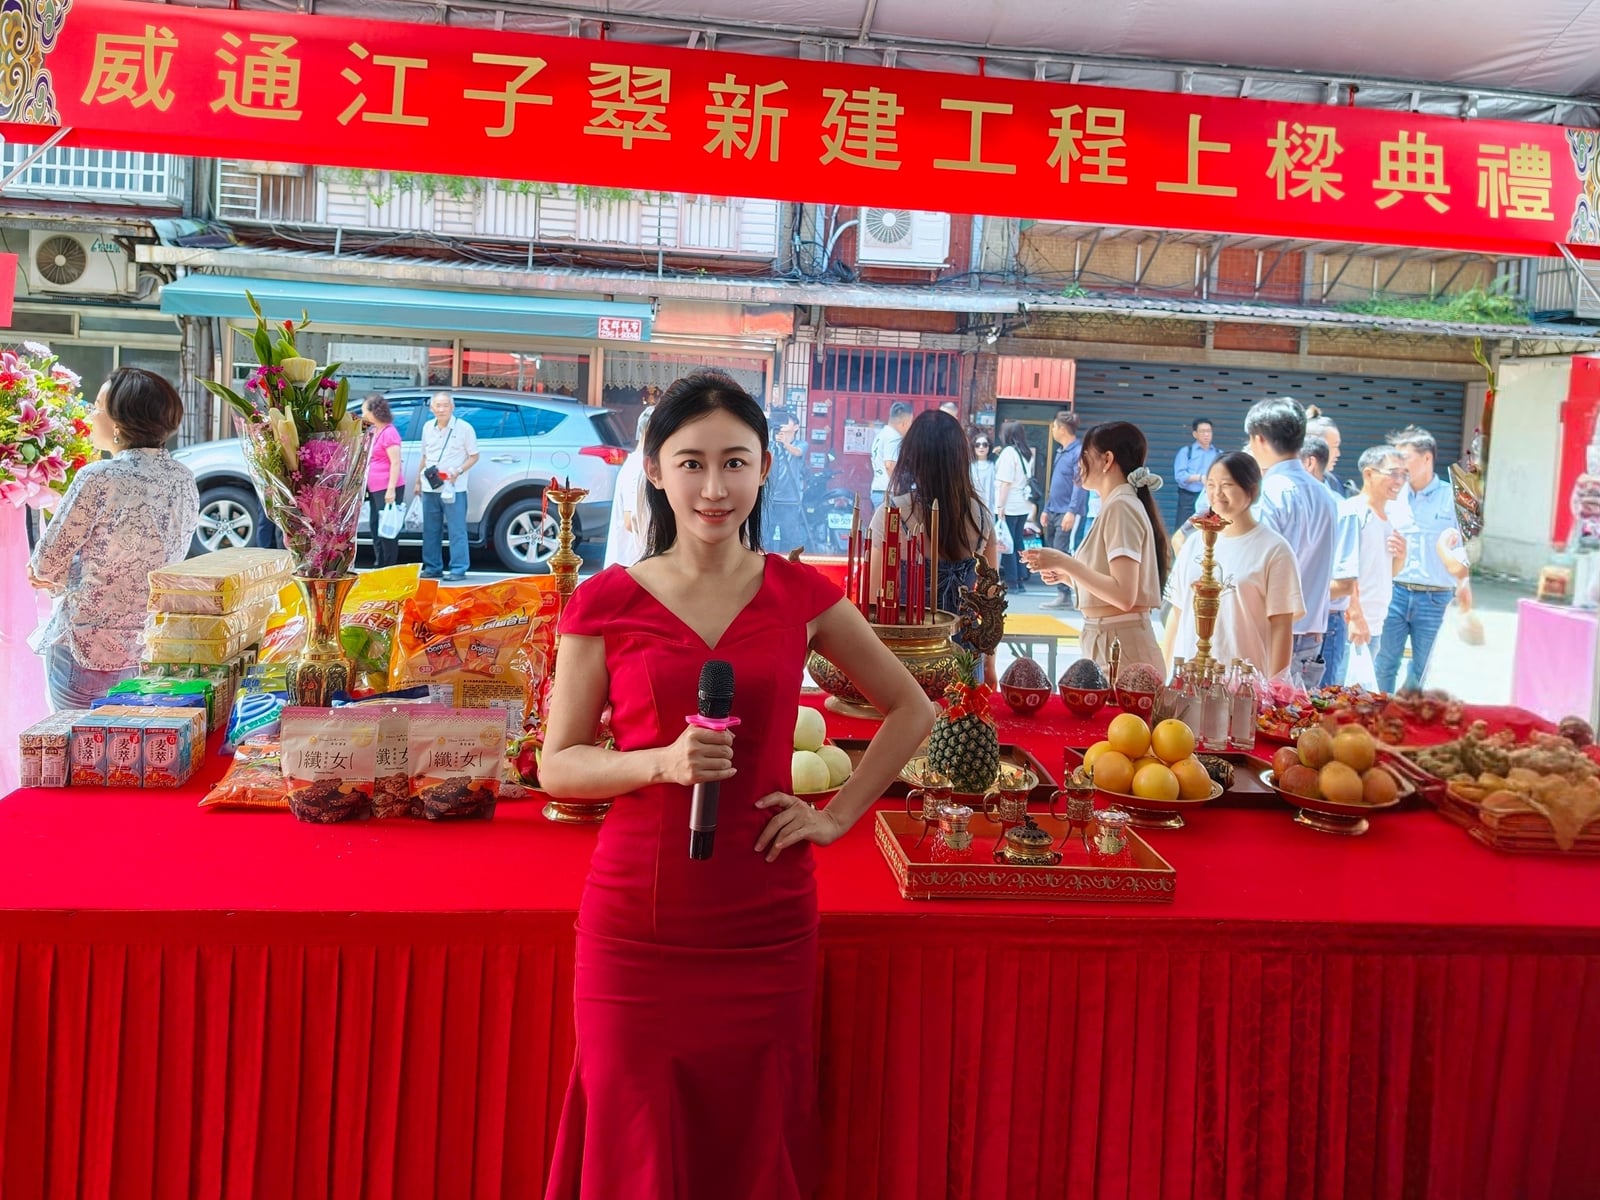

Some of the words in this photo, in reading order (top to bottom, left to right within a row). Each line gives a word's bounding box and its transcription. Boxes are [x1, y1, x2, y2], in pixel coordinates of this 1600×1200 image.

[81, 25, 1555, 223] 威通江子翠新建工程上樑典禮
[427, 642, 452, 653] Doritos
[471, 644, 495, 654] Doritos
